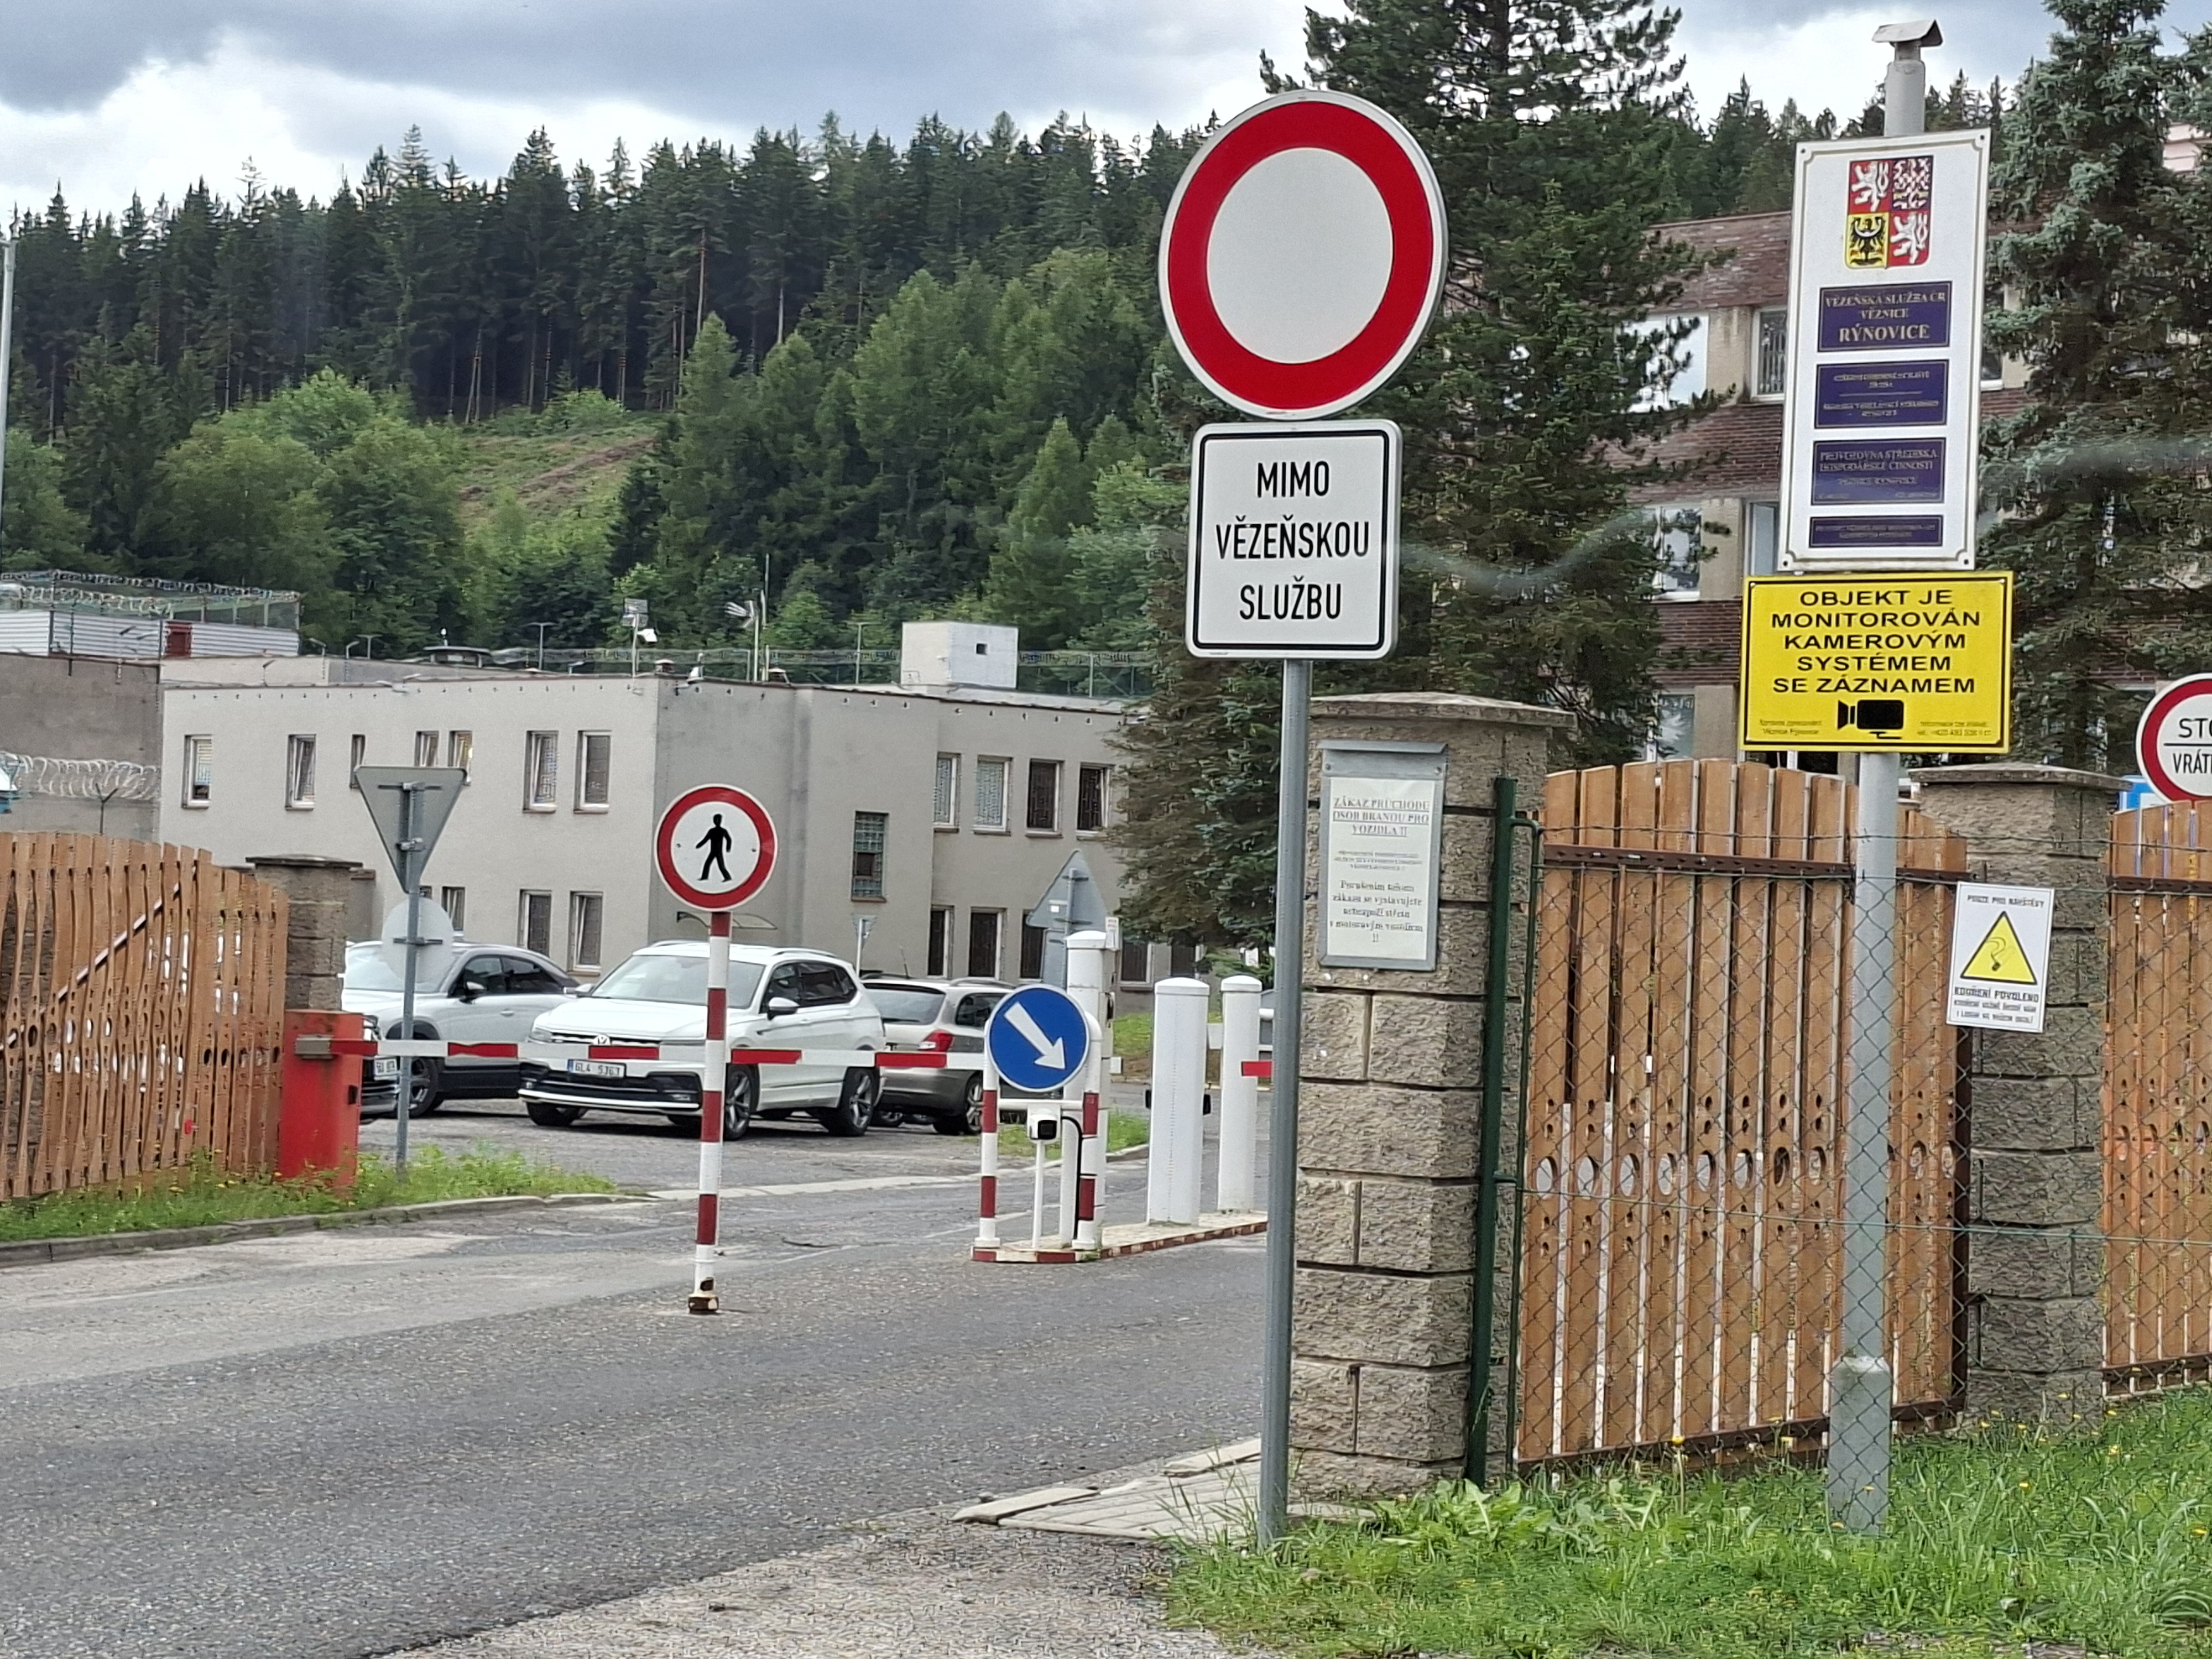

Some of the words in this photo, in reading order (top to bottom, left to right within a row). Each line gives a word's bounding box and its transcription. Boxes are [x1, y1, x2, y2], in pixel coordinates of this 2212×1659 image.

[1861, 306, 1910, 319] VĚZNICE
[1839, 323, 1930, 342] RÝNOVICE
[1257, 461, 1329, 498] MIMO
[1216, 514, 1369, 559] VĚZEŇSKOU
[1239, 575, 1341, 619] SLUŽBU
[1800, 590, 1911, 606] OBJEKT
[1918, 589, 1953, 605] JE
[1771, 608, 1981, 628] MONITOROVÁN
[1784, 630, 1965, 649] KAMEROVÝM
[1797, 653, 1951, 671] SYSTÉMEM
[1773, 678, 1808, 693] SE
[1816, 674, 1975, 693] ZÁZNAMEM
[2178, 718, 2212, 738] ST
[2173, 749, 2212, 774] VRÁT
[1353, 824, 1397, 835] VOZIDLA
[1994, 990, 2039, 1003] POVOLENO
